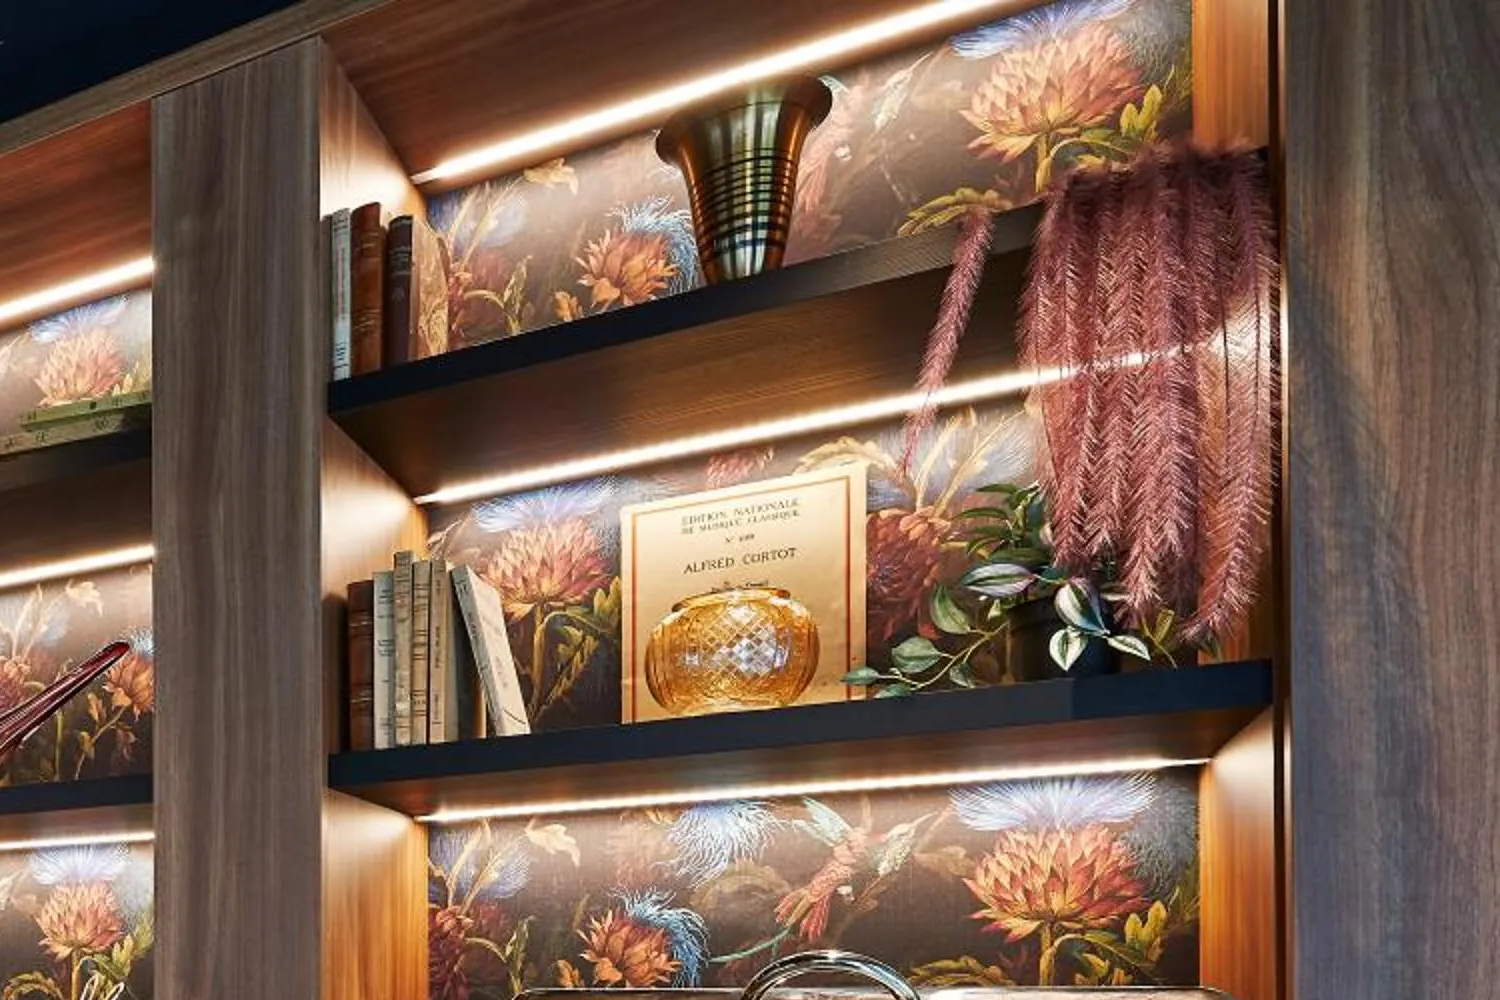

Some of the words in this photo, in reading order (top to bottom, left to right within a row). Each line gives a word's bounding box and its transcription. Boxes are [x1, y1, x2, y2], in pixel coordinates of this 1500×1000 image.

[734, 498, 799, 516] NATIONALE
[683, 556, 735, 574] ALFRED
[742, 547, 796, 565] CORTOT
